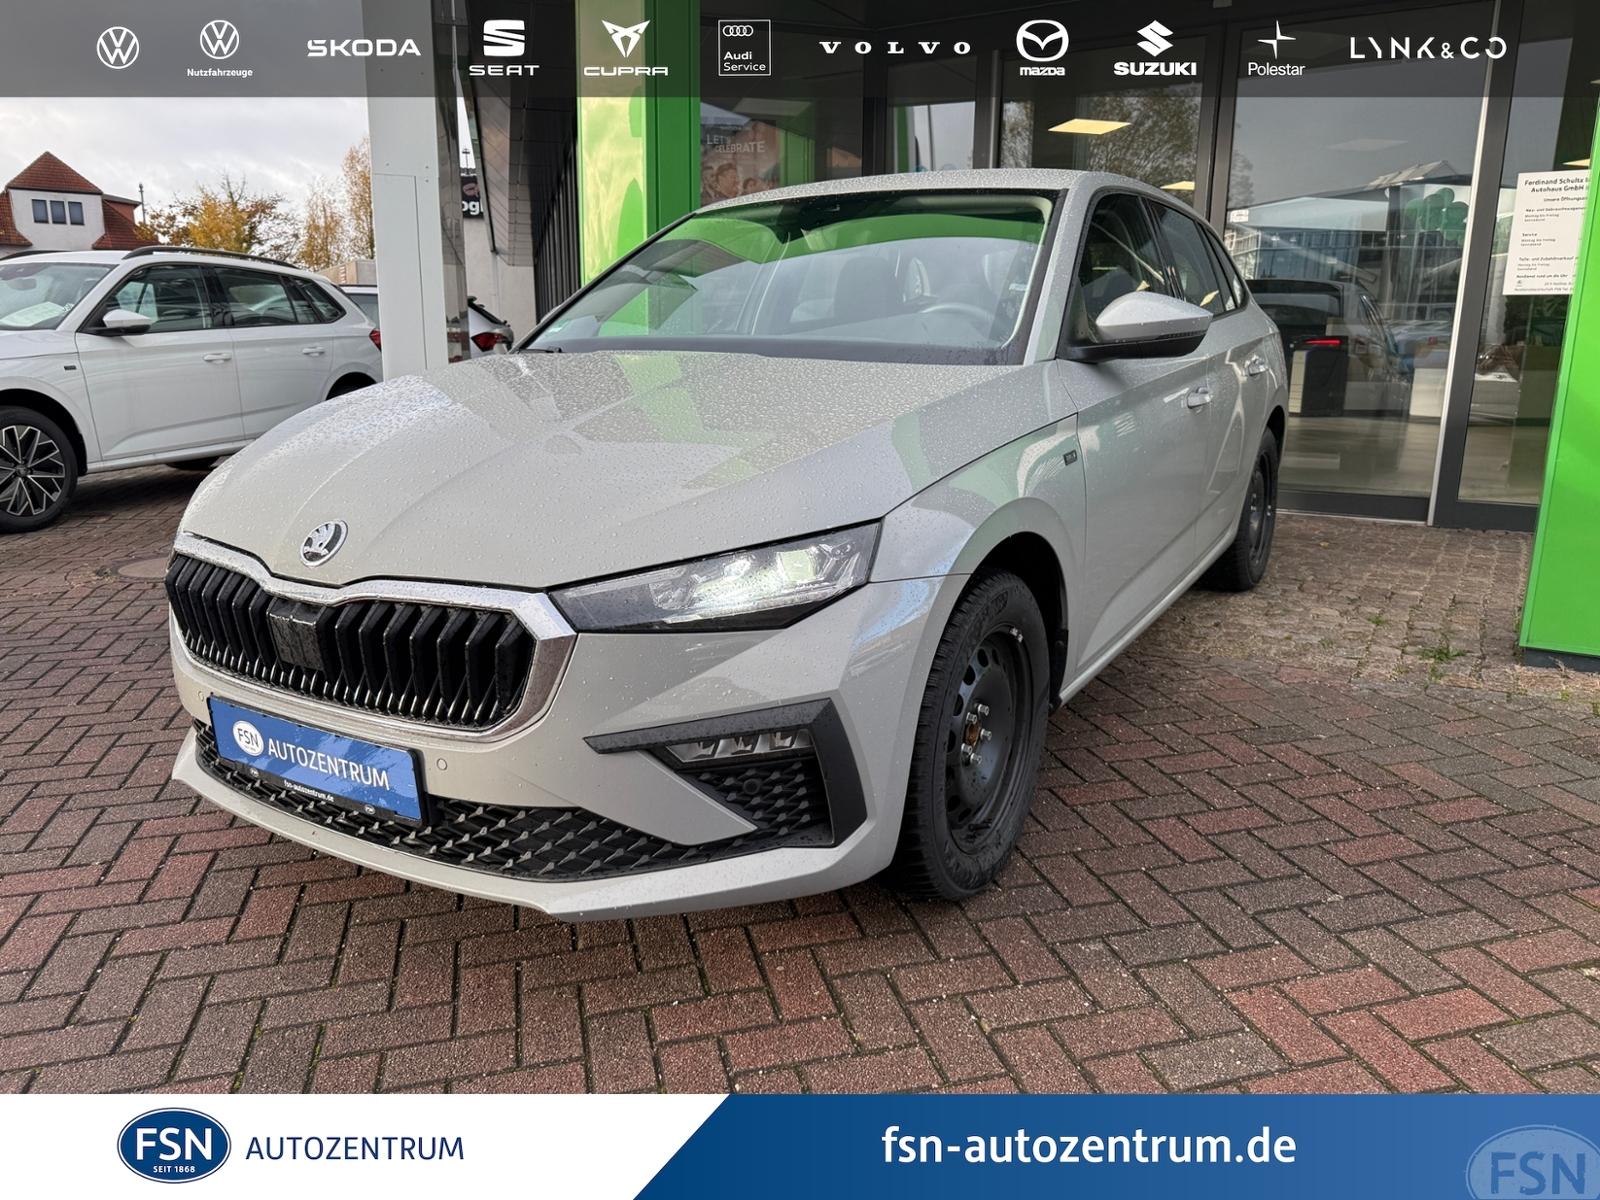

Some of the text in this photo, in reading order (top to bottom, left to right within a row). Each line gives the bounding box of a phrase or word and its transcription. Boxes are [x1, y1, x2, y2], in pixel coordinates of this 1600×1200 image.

[1524, 178, 1558, 186] Ferdinand
[237, 727, 391, 791] FSN AUTOZENTRUM
